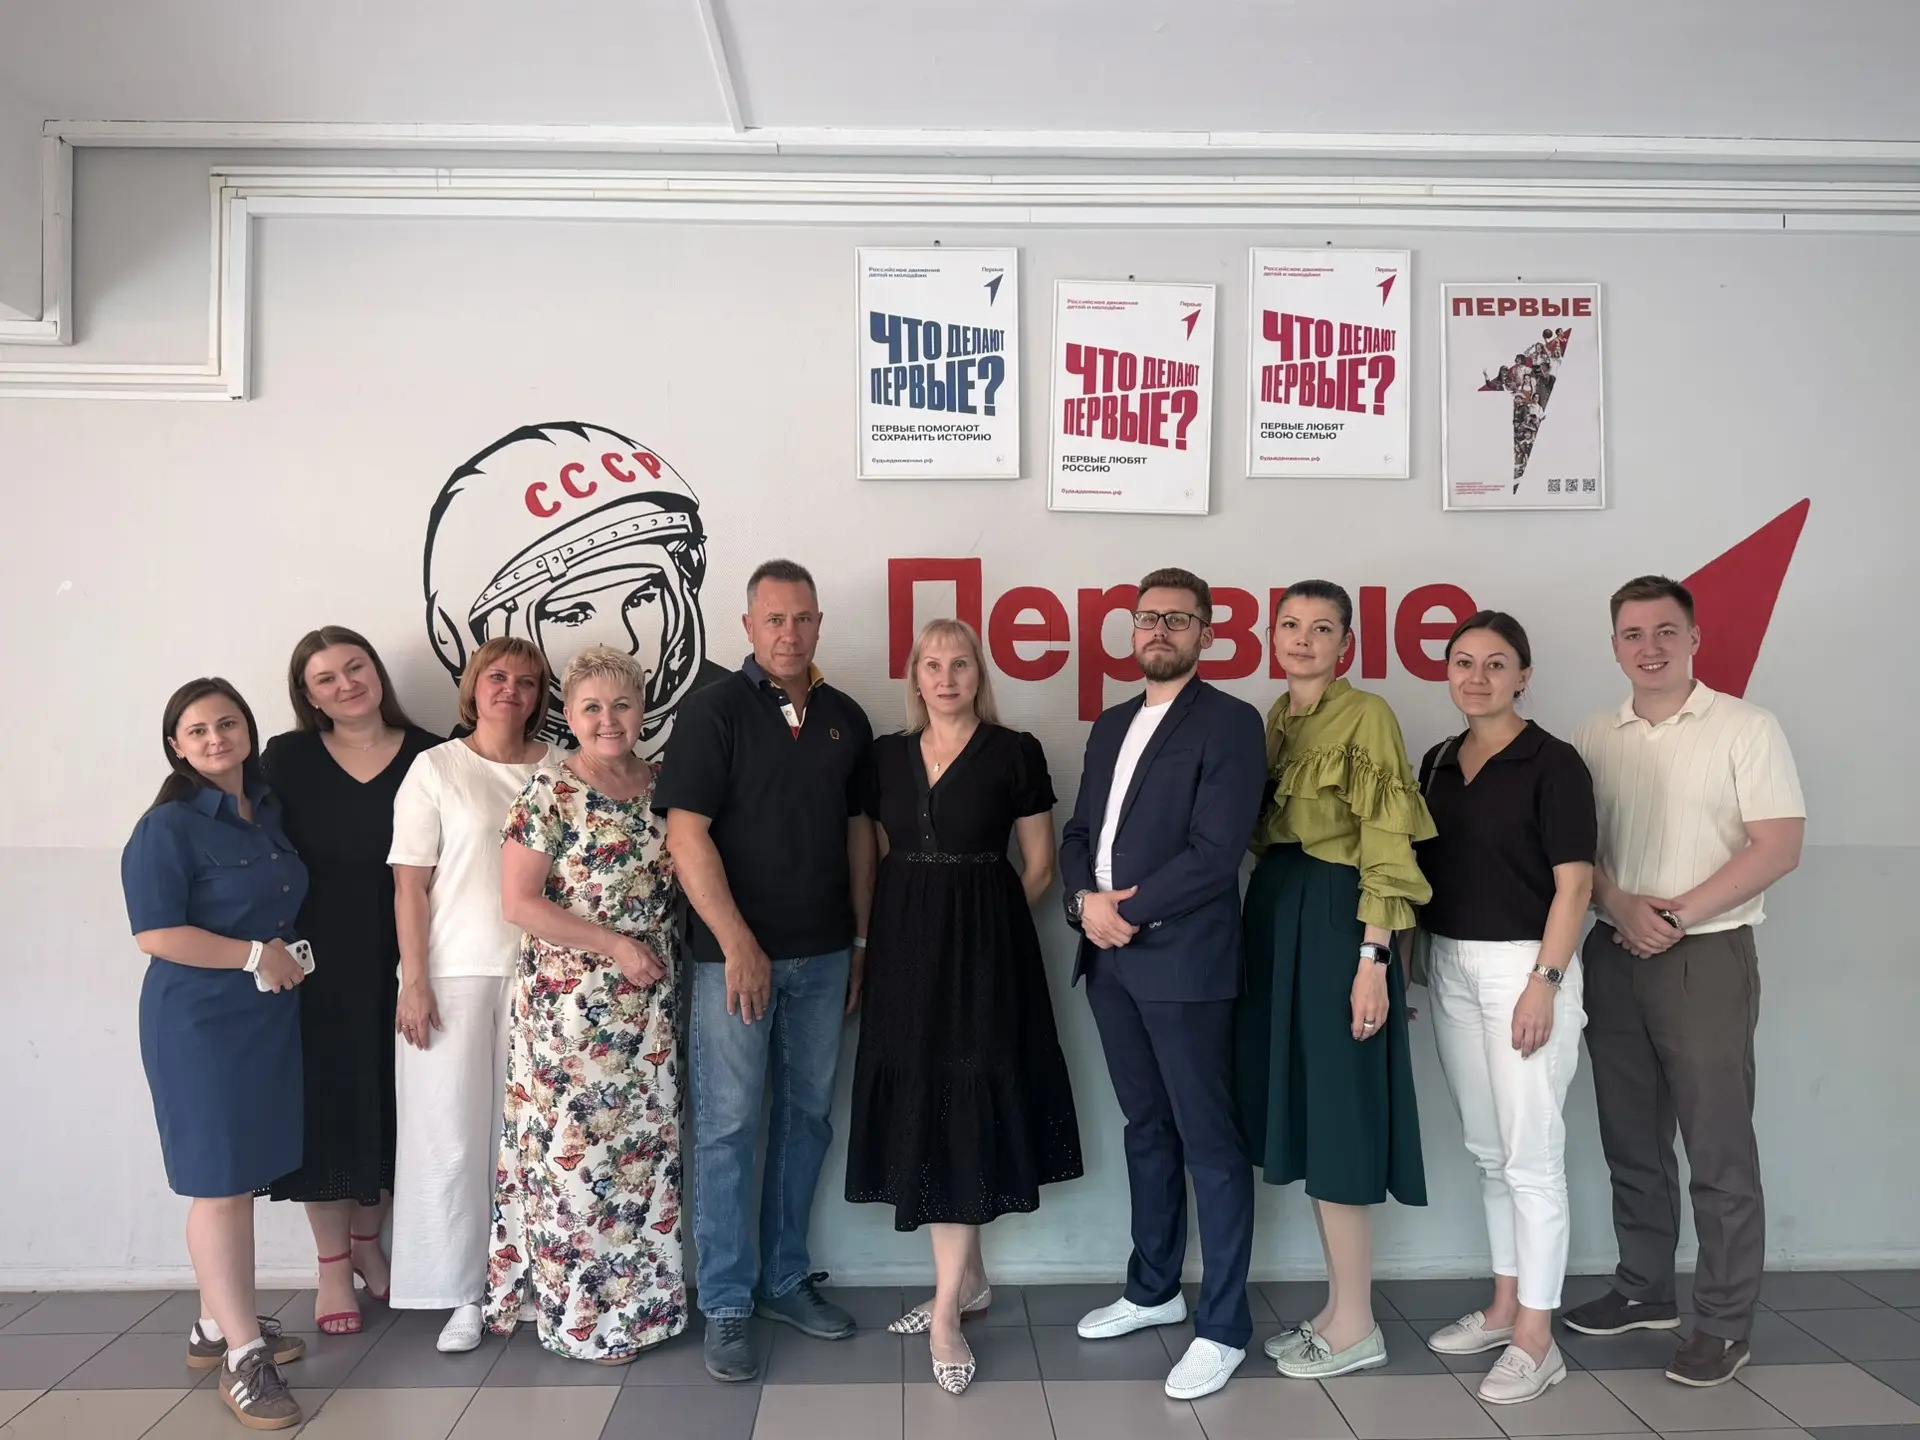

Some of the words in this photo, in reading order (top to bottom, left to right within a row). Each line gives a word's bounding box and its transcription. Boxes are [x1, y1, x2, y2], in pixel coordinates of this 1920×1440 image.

[1452, 297, 1592, 317] ПЕРВЫЕ
[869, 310, 942, 364] ЧТО
[947, 323, 1005, 358] ДЕЛАЮТ
[1262, 309, 1334, 362] ЧТО
[1337, 322, 1397, 356] ДЕЛАЮТ
[870, 354, 1005, 417] ПЕРВЫЕ?
[1065, 342, 1137, 395] ЧТО
[1140, 355, 1200, 390] ДЕЛАЮТ
[1261, 354, 1396, 416] ПЕРВЫЕ?
[871, 424, 916, 432] ПЕРВЫЕ
[917, 424, 980, 433] ПОМОГАЮТ
[871, 433, 935, 441] СОХРАНИТЬ
[937, 433, 992, 441] ИСТОРИЮ
[1063, 389, 1198, 451] ПЕРВЫЕ?
[1260, 422, 1304, 431] ПЕРВЫЕ
[1305, 422, 1345, 431] ЛЮБЯТ
[1260, 431, 1294, 439] СВОЮ
[1295, 431, 1337, 440] СЕМЬЮ
[1062, 455, 1107, 464] ПЕРВЫЕ
[1108, 456, 1148, 465] ЛЮБЯТ
[1062, 464, 1111, 473] РОССИЮ
[525, 452, 661, 518] СССР
